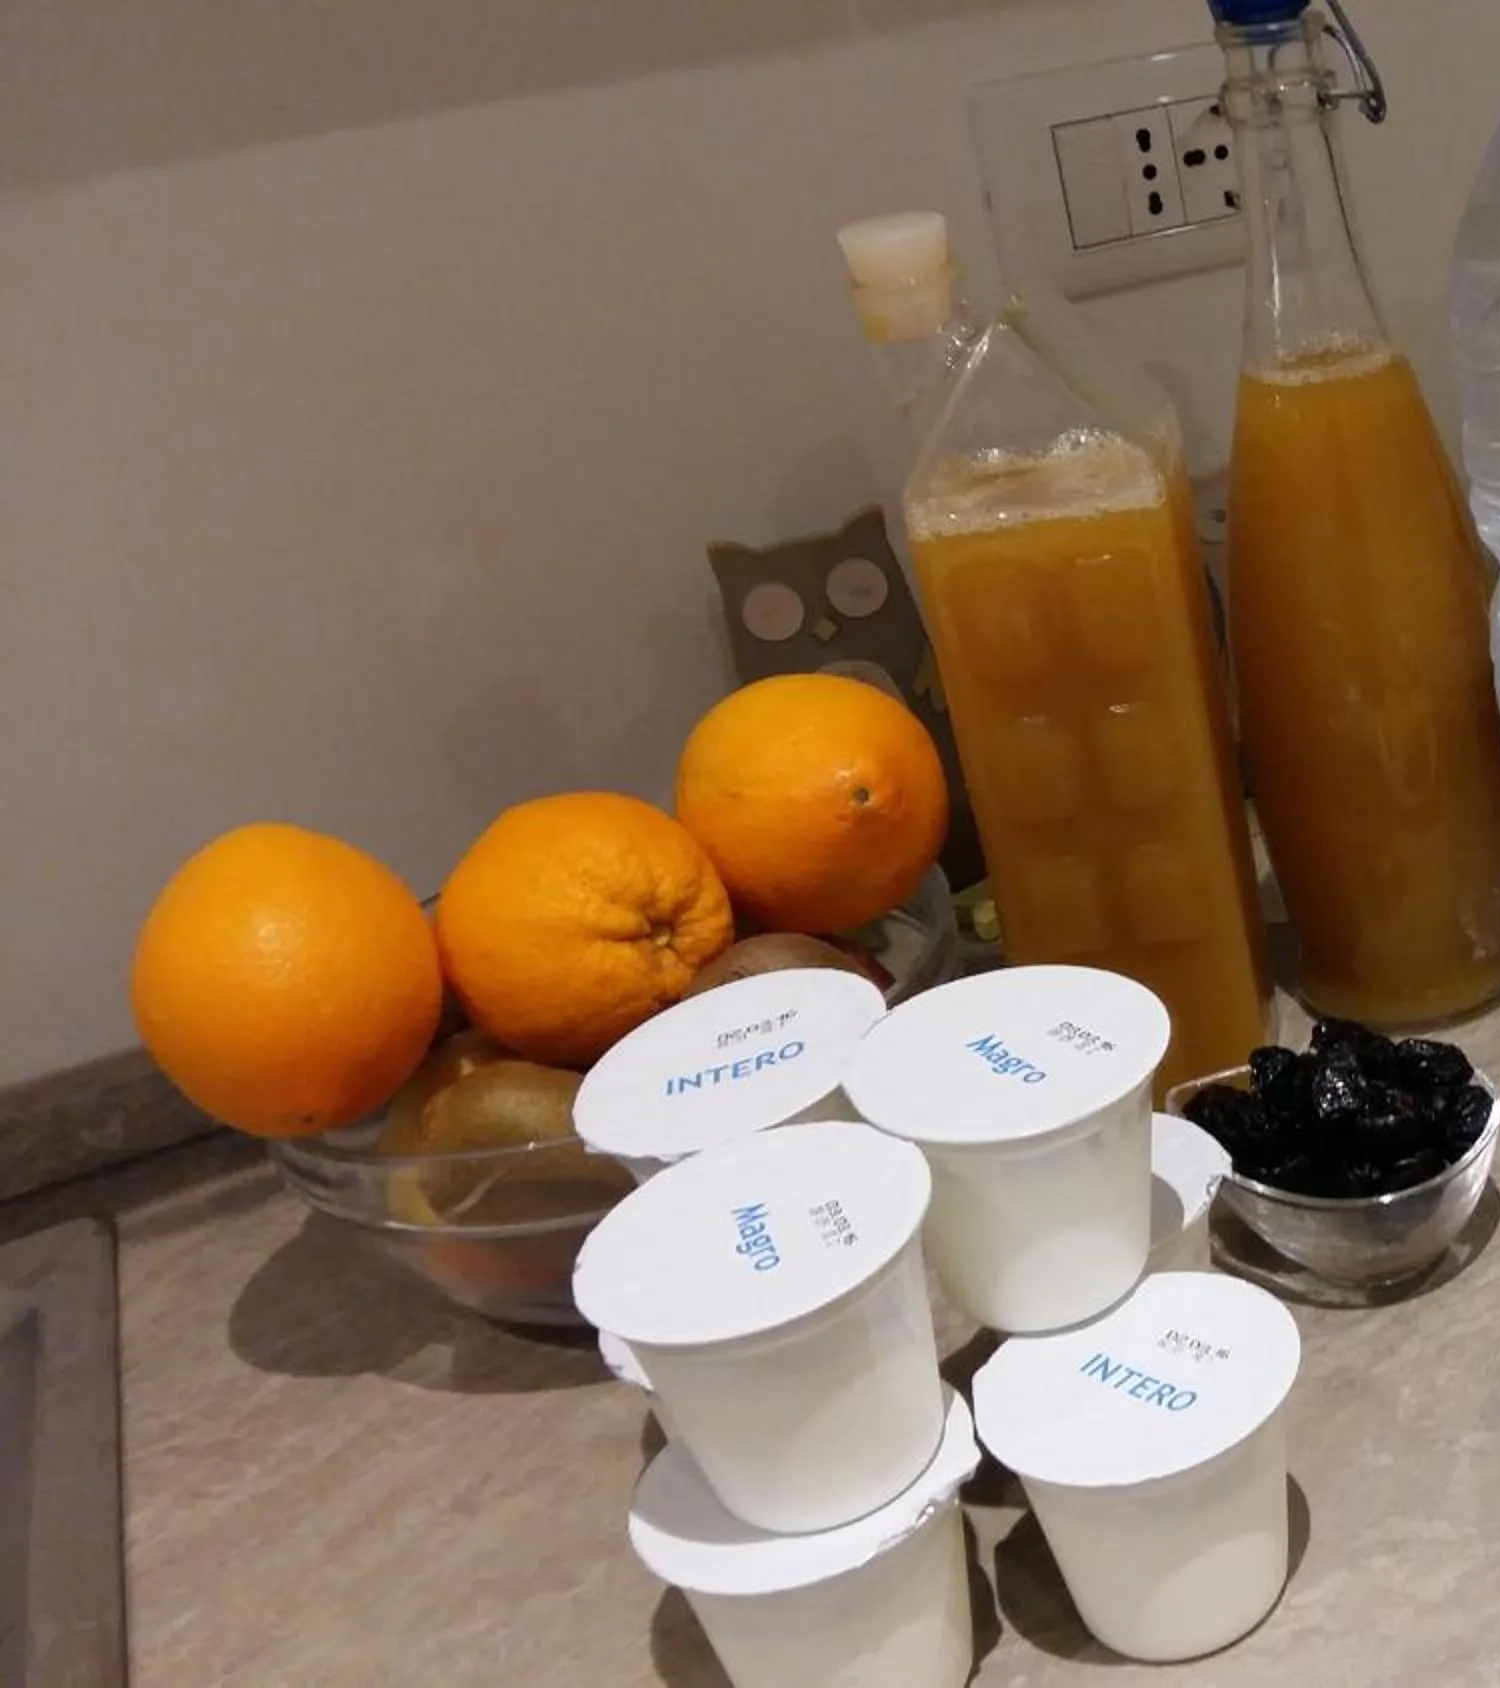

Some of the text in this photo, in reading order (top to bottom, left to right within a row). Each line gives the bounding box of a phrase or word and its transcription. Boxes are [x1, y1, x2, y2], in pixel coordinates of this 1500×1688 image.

[666, 1041, 804, 1095] INTERO
[965, 1033, 1047, 1083] Magro
[731, 1202, 781, 1271] Magro
[1080, 1353, 1198, 1411] INTERO
